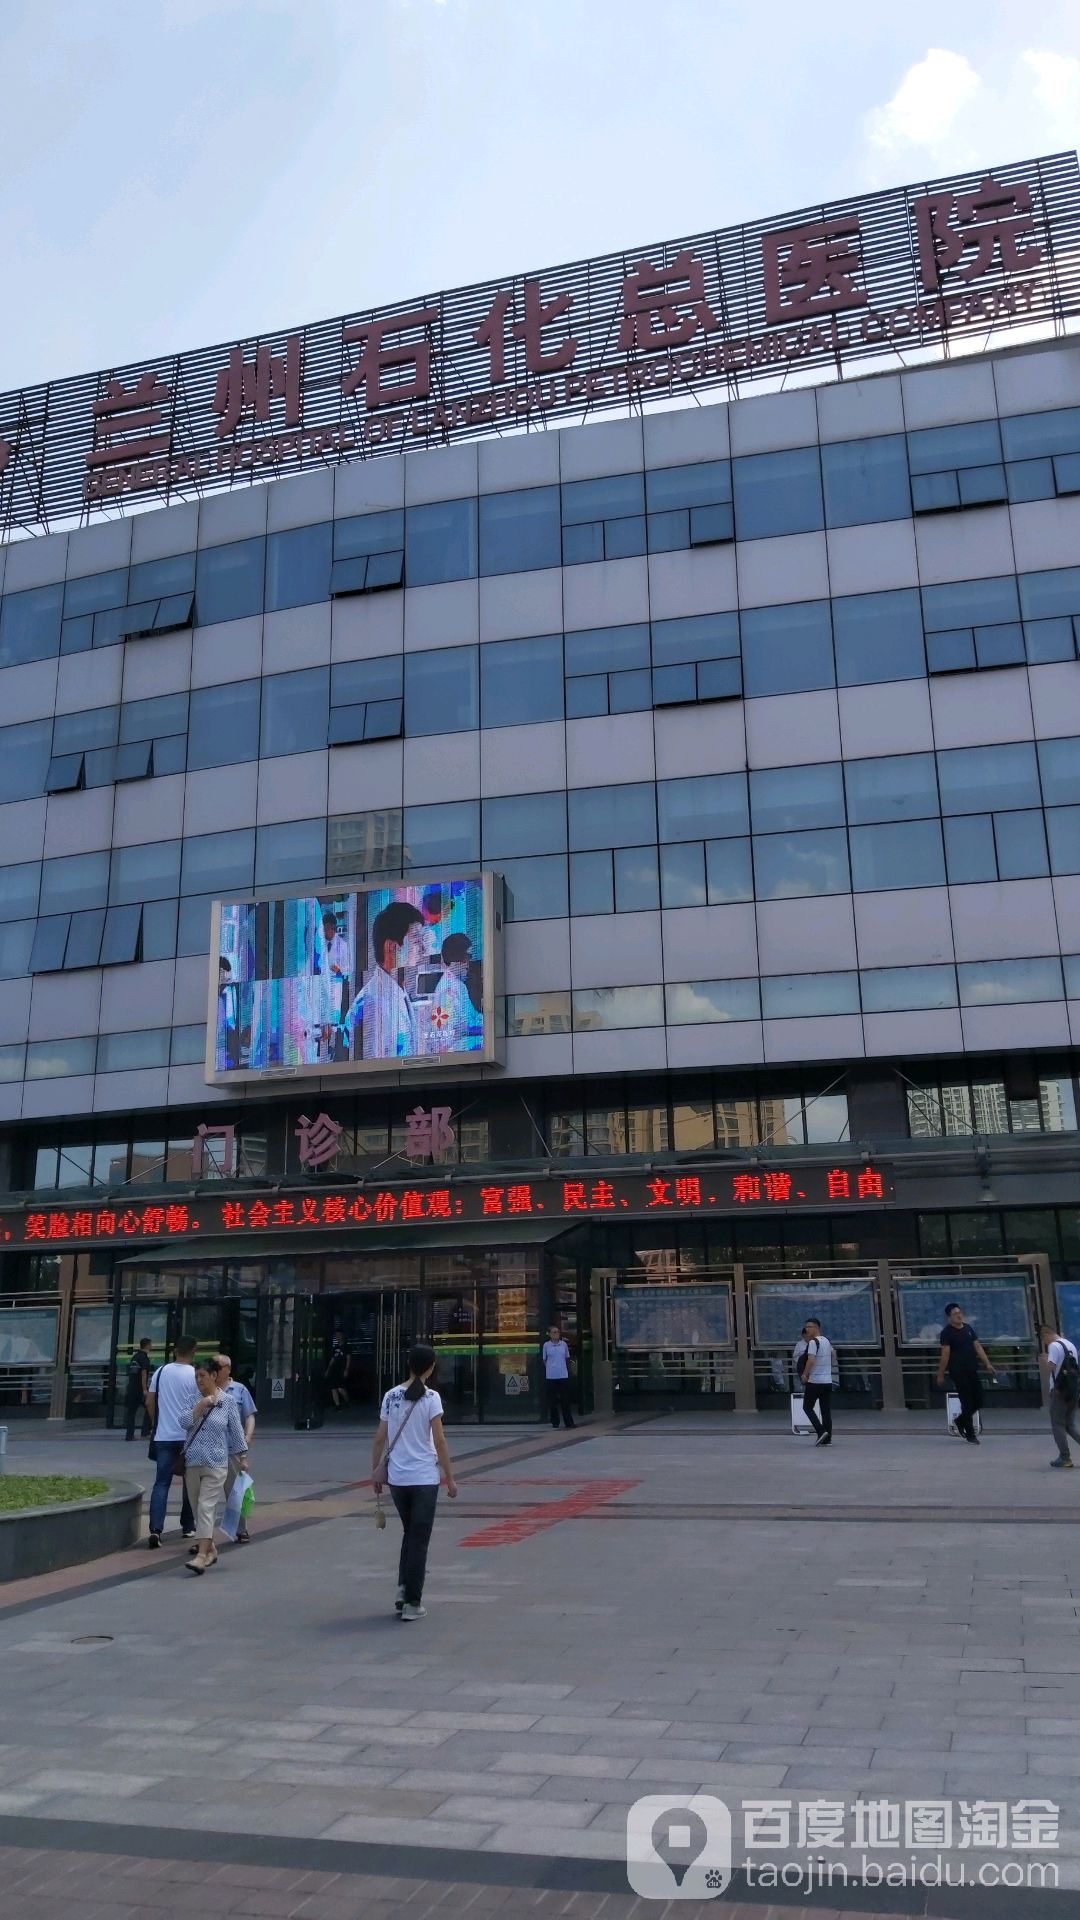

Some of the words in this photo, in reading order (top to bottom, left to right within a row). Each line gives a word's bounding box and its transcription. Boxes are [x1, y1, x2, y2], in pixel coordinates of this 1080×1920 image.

[82, 453, 210, 500] GENERAL
[217, 427, 355, 473] HOSPITAL
[364, 413, 404, 443] OF
[411, 384, 555, 435] LANZHOU
[565, 321, 850, 400] PETROCHEMICAL
[861, 281, 1043, 342] COMPANY
[85, 176, 1042, 468] 兰州石化总医院
[191, 1106, 454, 1173] 门诊部
[0, 1204, 200, 1241] 、笑脸相向心舒畅。
